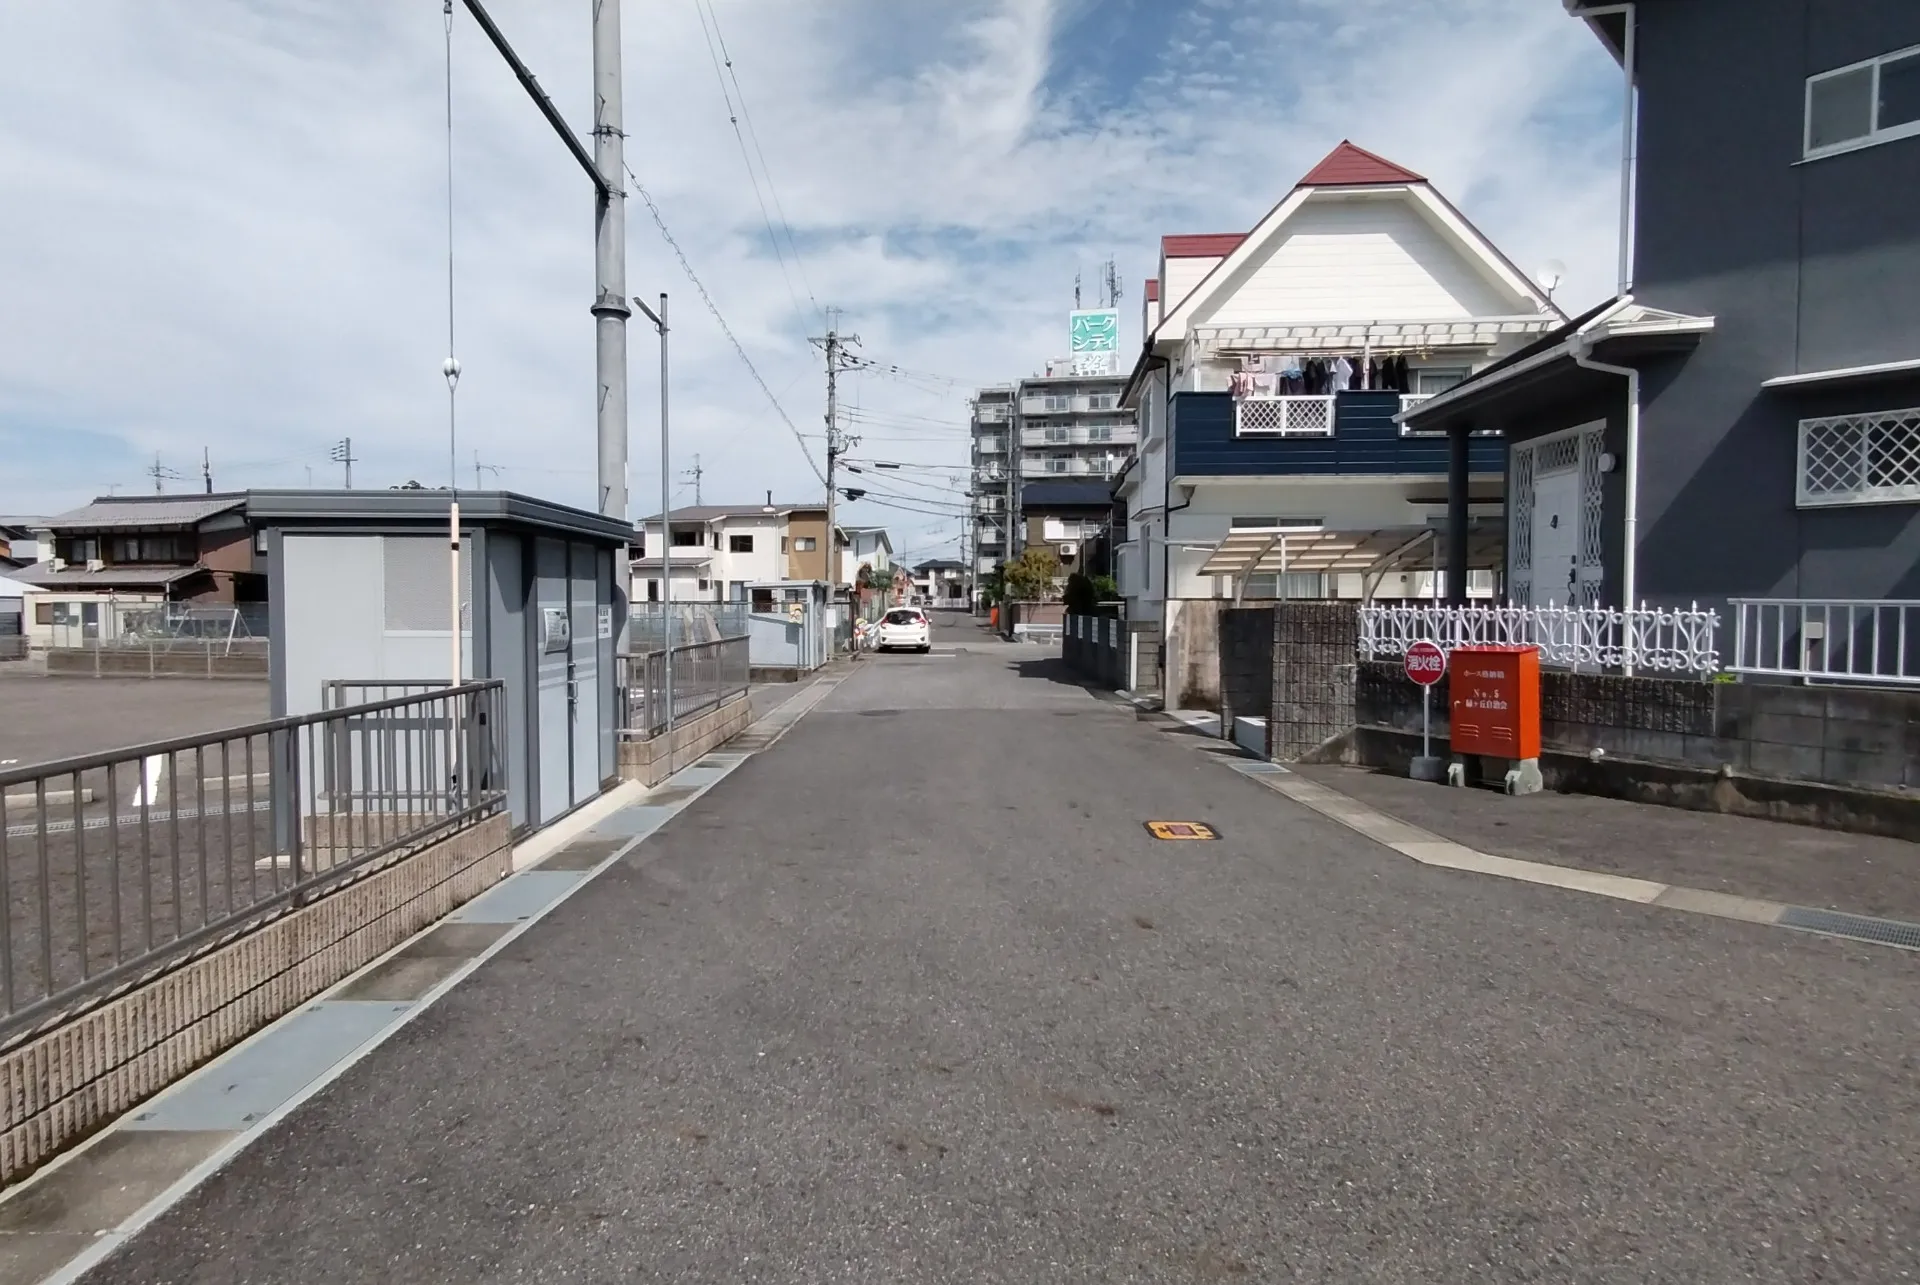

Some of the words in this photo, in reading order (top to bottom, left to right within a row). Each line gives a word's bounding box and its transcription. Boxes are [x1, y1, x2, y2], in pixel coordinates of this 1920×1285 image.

[1073, 334, 1114, 350] シティ
[1408, 654, 1441, 671] 消火栓
